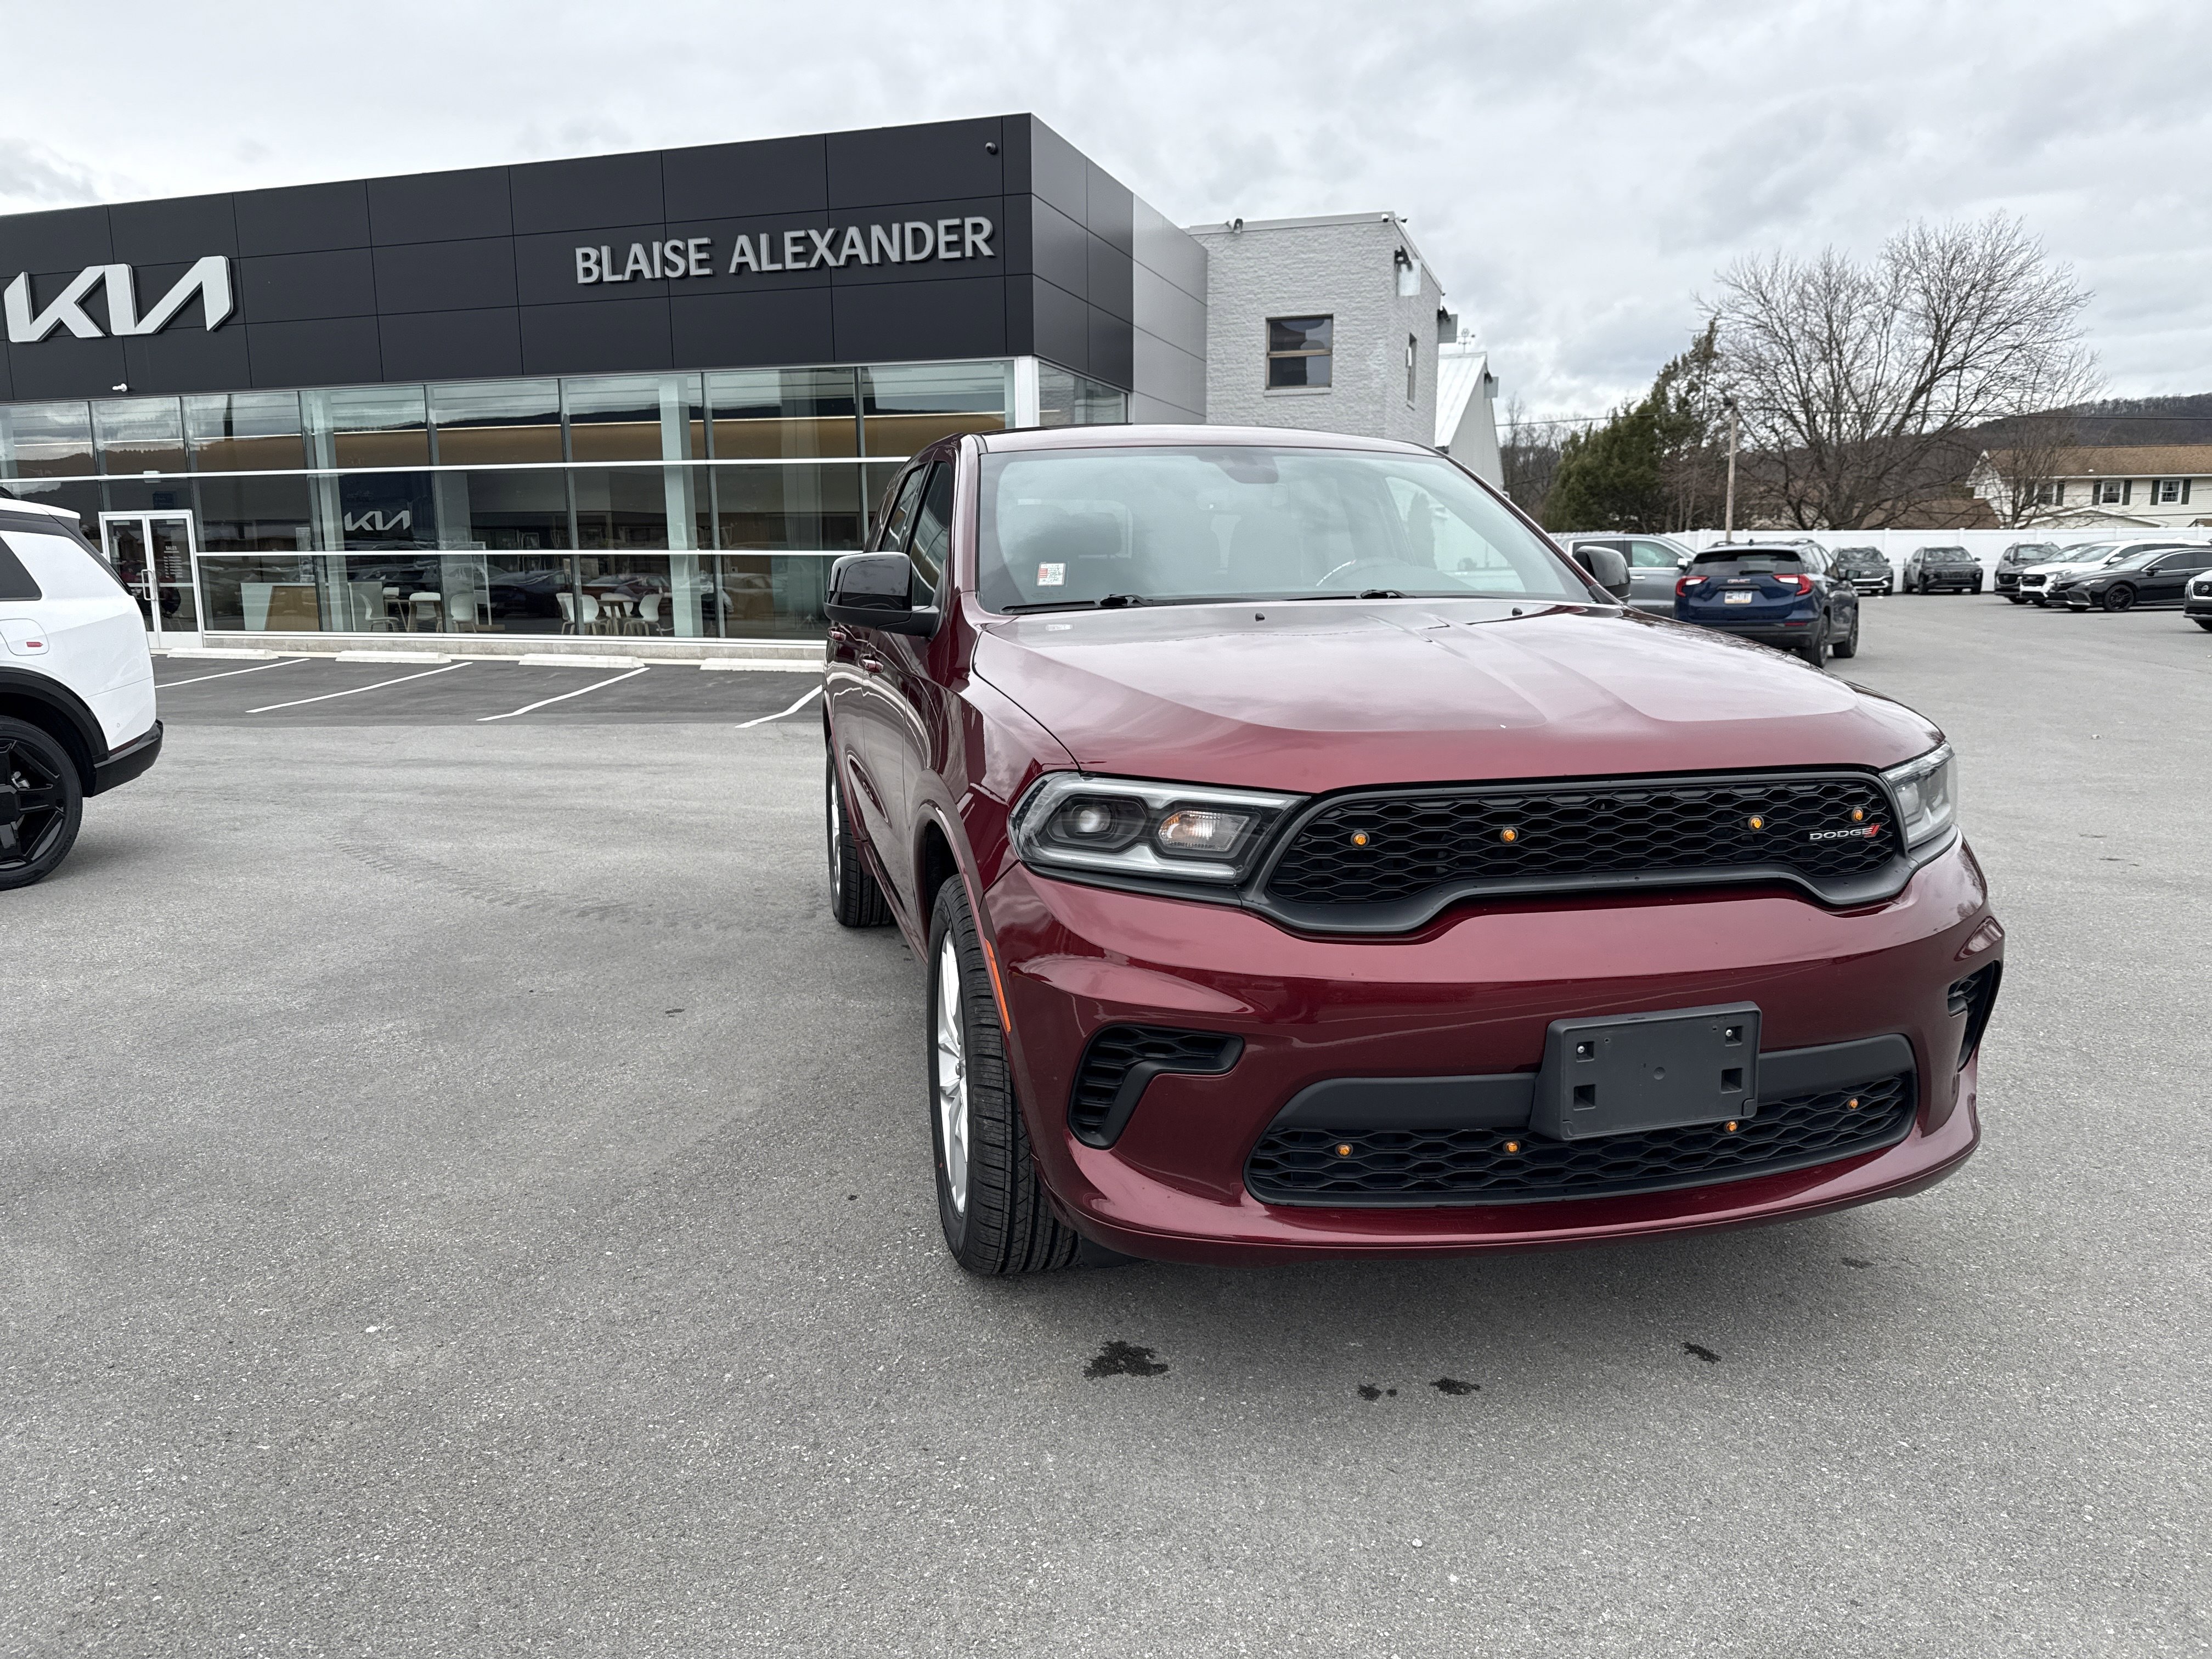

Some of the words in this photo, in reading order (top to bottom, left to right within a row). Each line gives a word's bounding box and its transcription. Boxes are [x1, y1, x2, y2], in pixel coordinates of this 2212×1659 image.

[575, 238, 713, 284] BLAISE
[729, 217, 995, 273] ALEXANDER
[4, 256, 233, 343] KIA
[345, 510, 410, 531] KIA
[1809, 827, 1874, 840] DODGE
